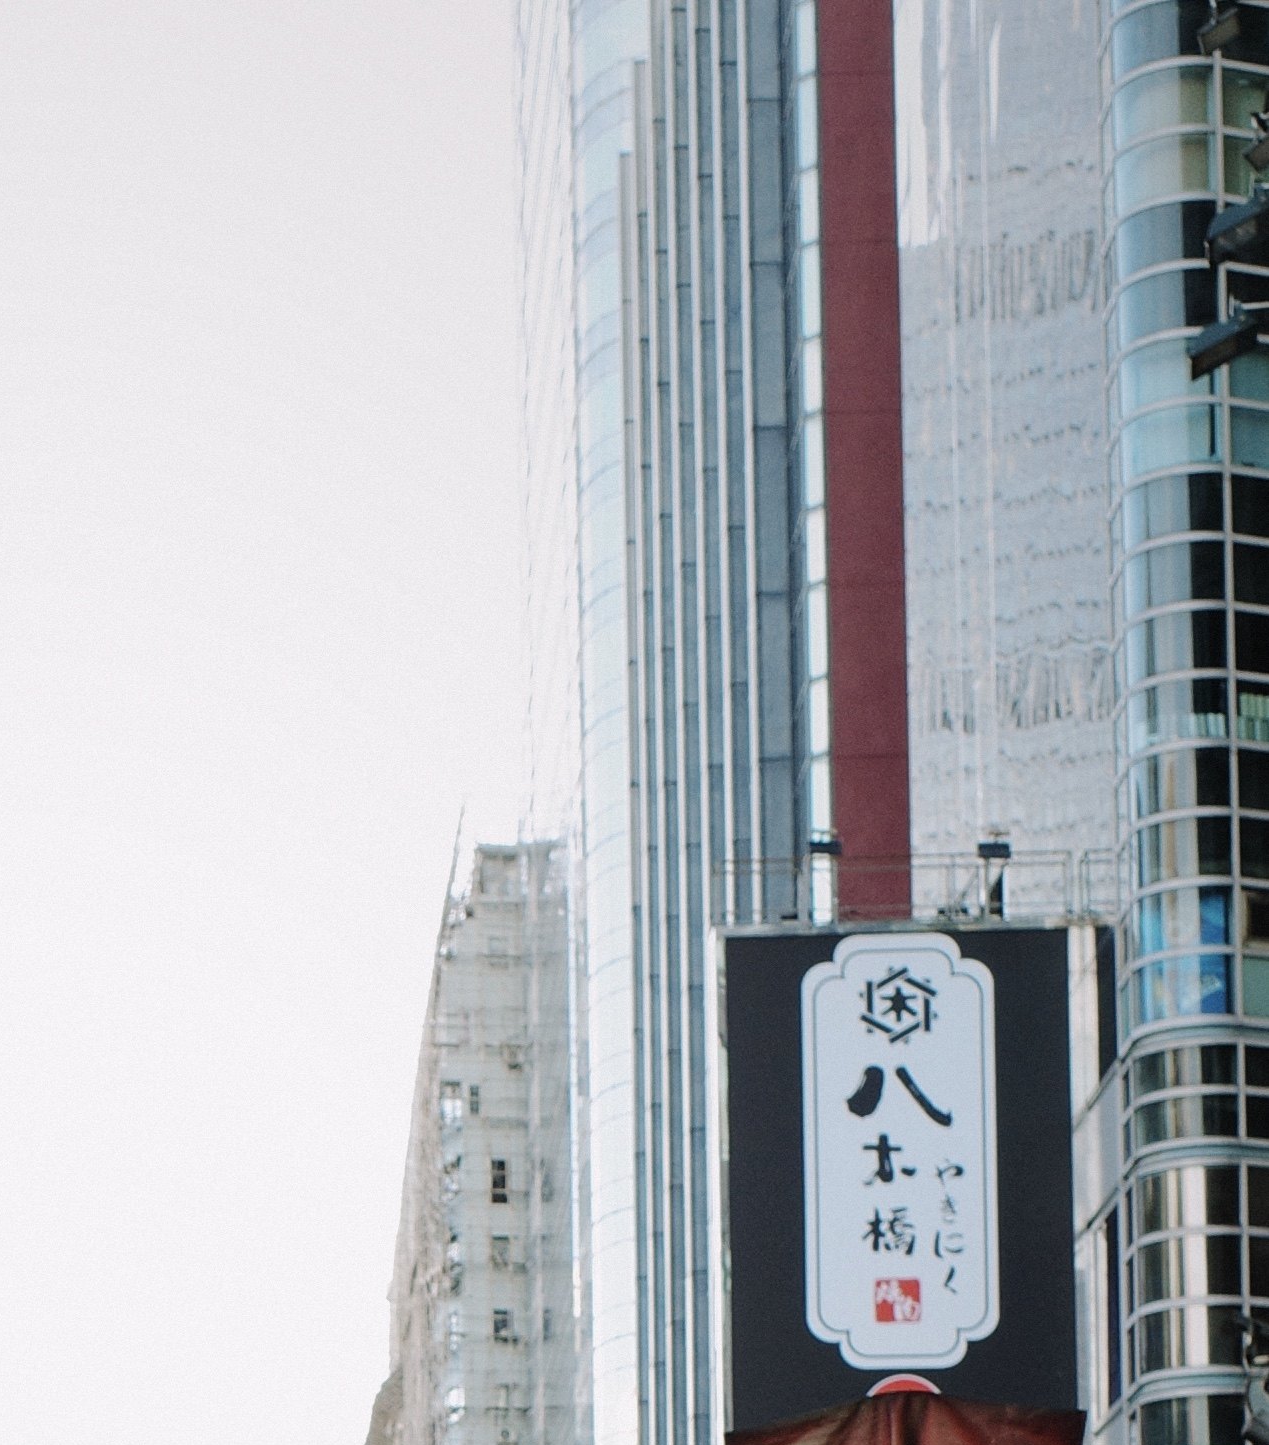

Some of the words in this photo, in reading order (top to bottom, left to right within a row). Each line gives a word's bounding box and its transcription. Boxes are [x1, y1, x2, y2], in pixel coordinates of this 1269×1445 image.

[847, 1066, 952, 1255] 八木橋
[936, 1158, 964, 1294] やきにく
